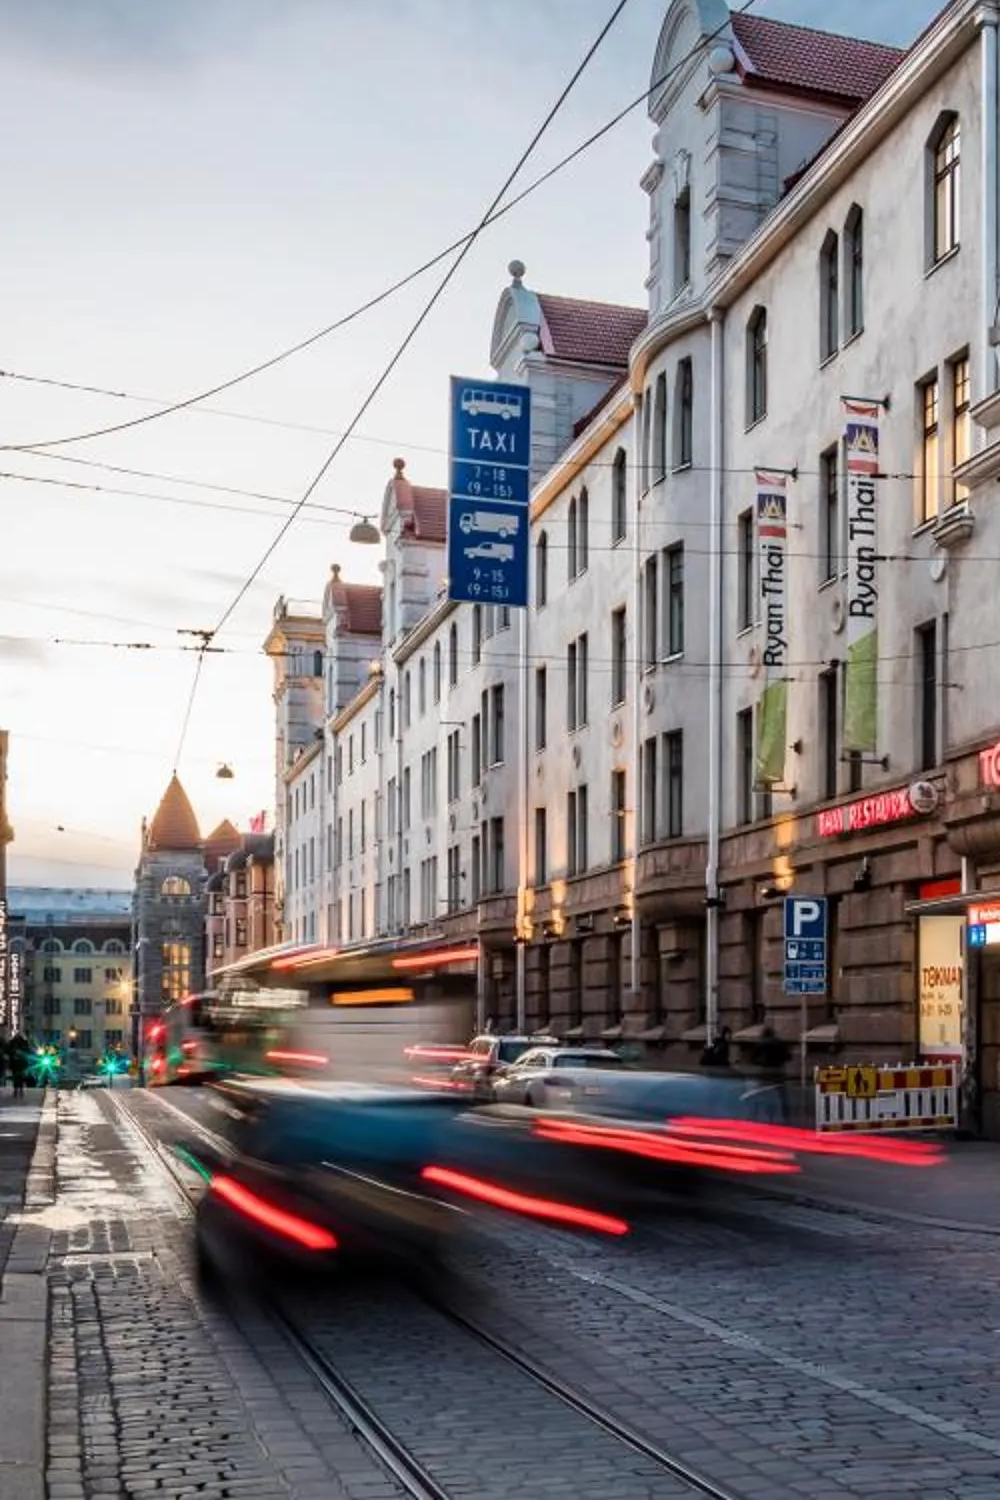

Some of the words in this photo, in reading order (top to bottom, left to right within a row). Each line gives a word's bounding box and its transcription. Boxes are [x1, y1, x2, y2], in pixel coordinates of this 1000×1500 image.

[467, 428, 516, 452] TAXI
[849, 480, 875, 541] Thai
[762, 544, 784, 597] Thai
[849, 547, 878, 618] Ryan
[763, 603, 788, 667] Ryan
[793, 901, 820, 936] P
